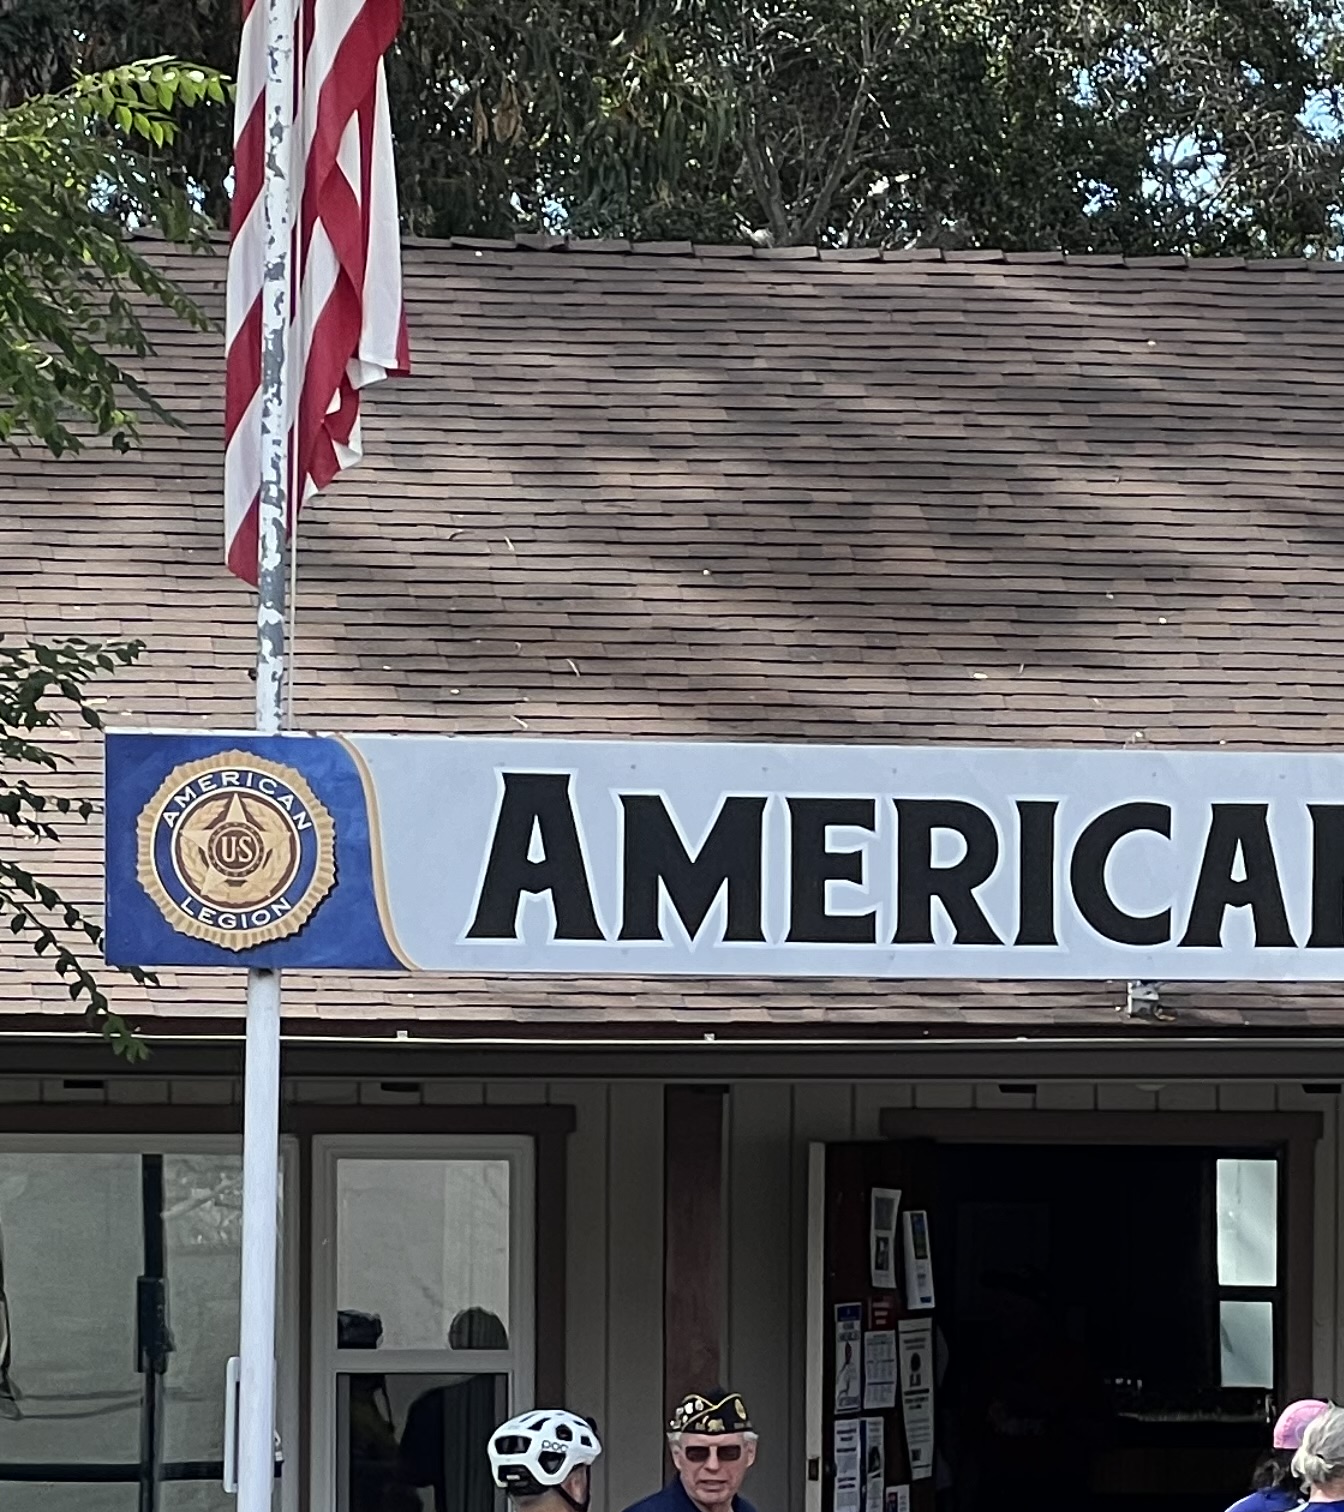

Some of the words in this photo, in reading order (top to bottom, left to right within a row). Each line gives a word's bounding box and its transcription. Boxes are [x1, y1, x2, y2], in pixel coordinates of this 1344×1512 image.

[162, 771, 313, 832] AMERICAN
[221, 836, 253, 863] US
[180, 896, 293, 930] LEGION
